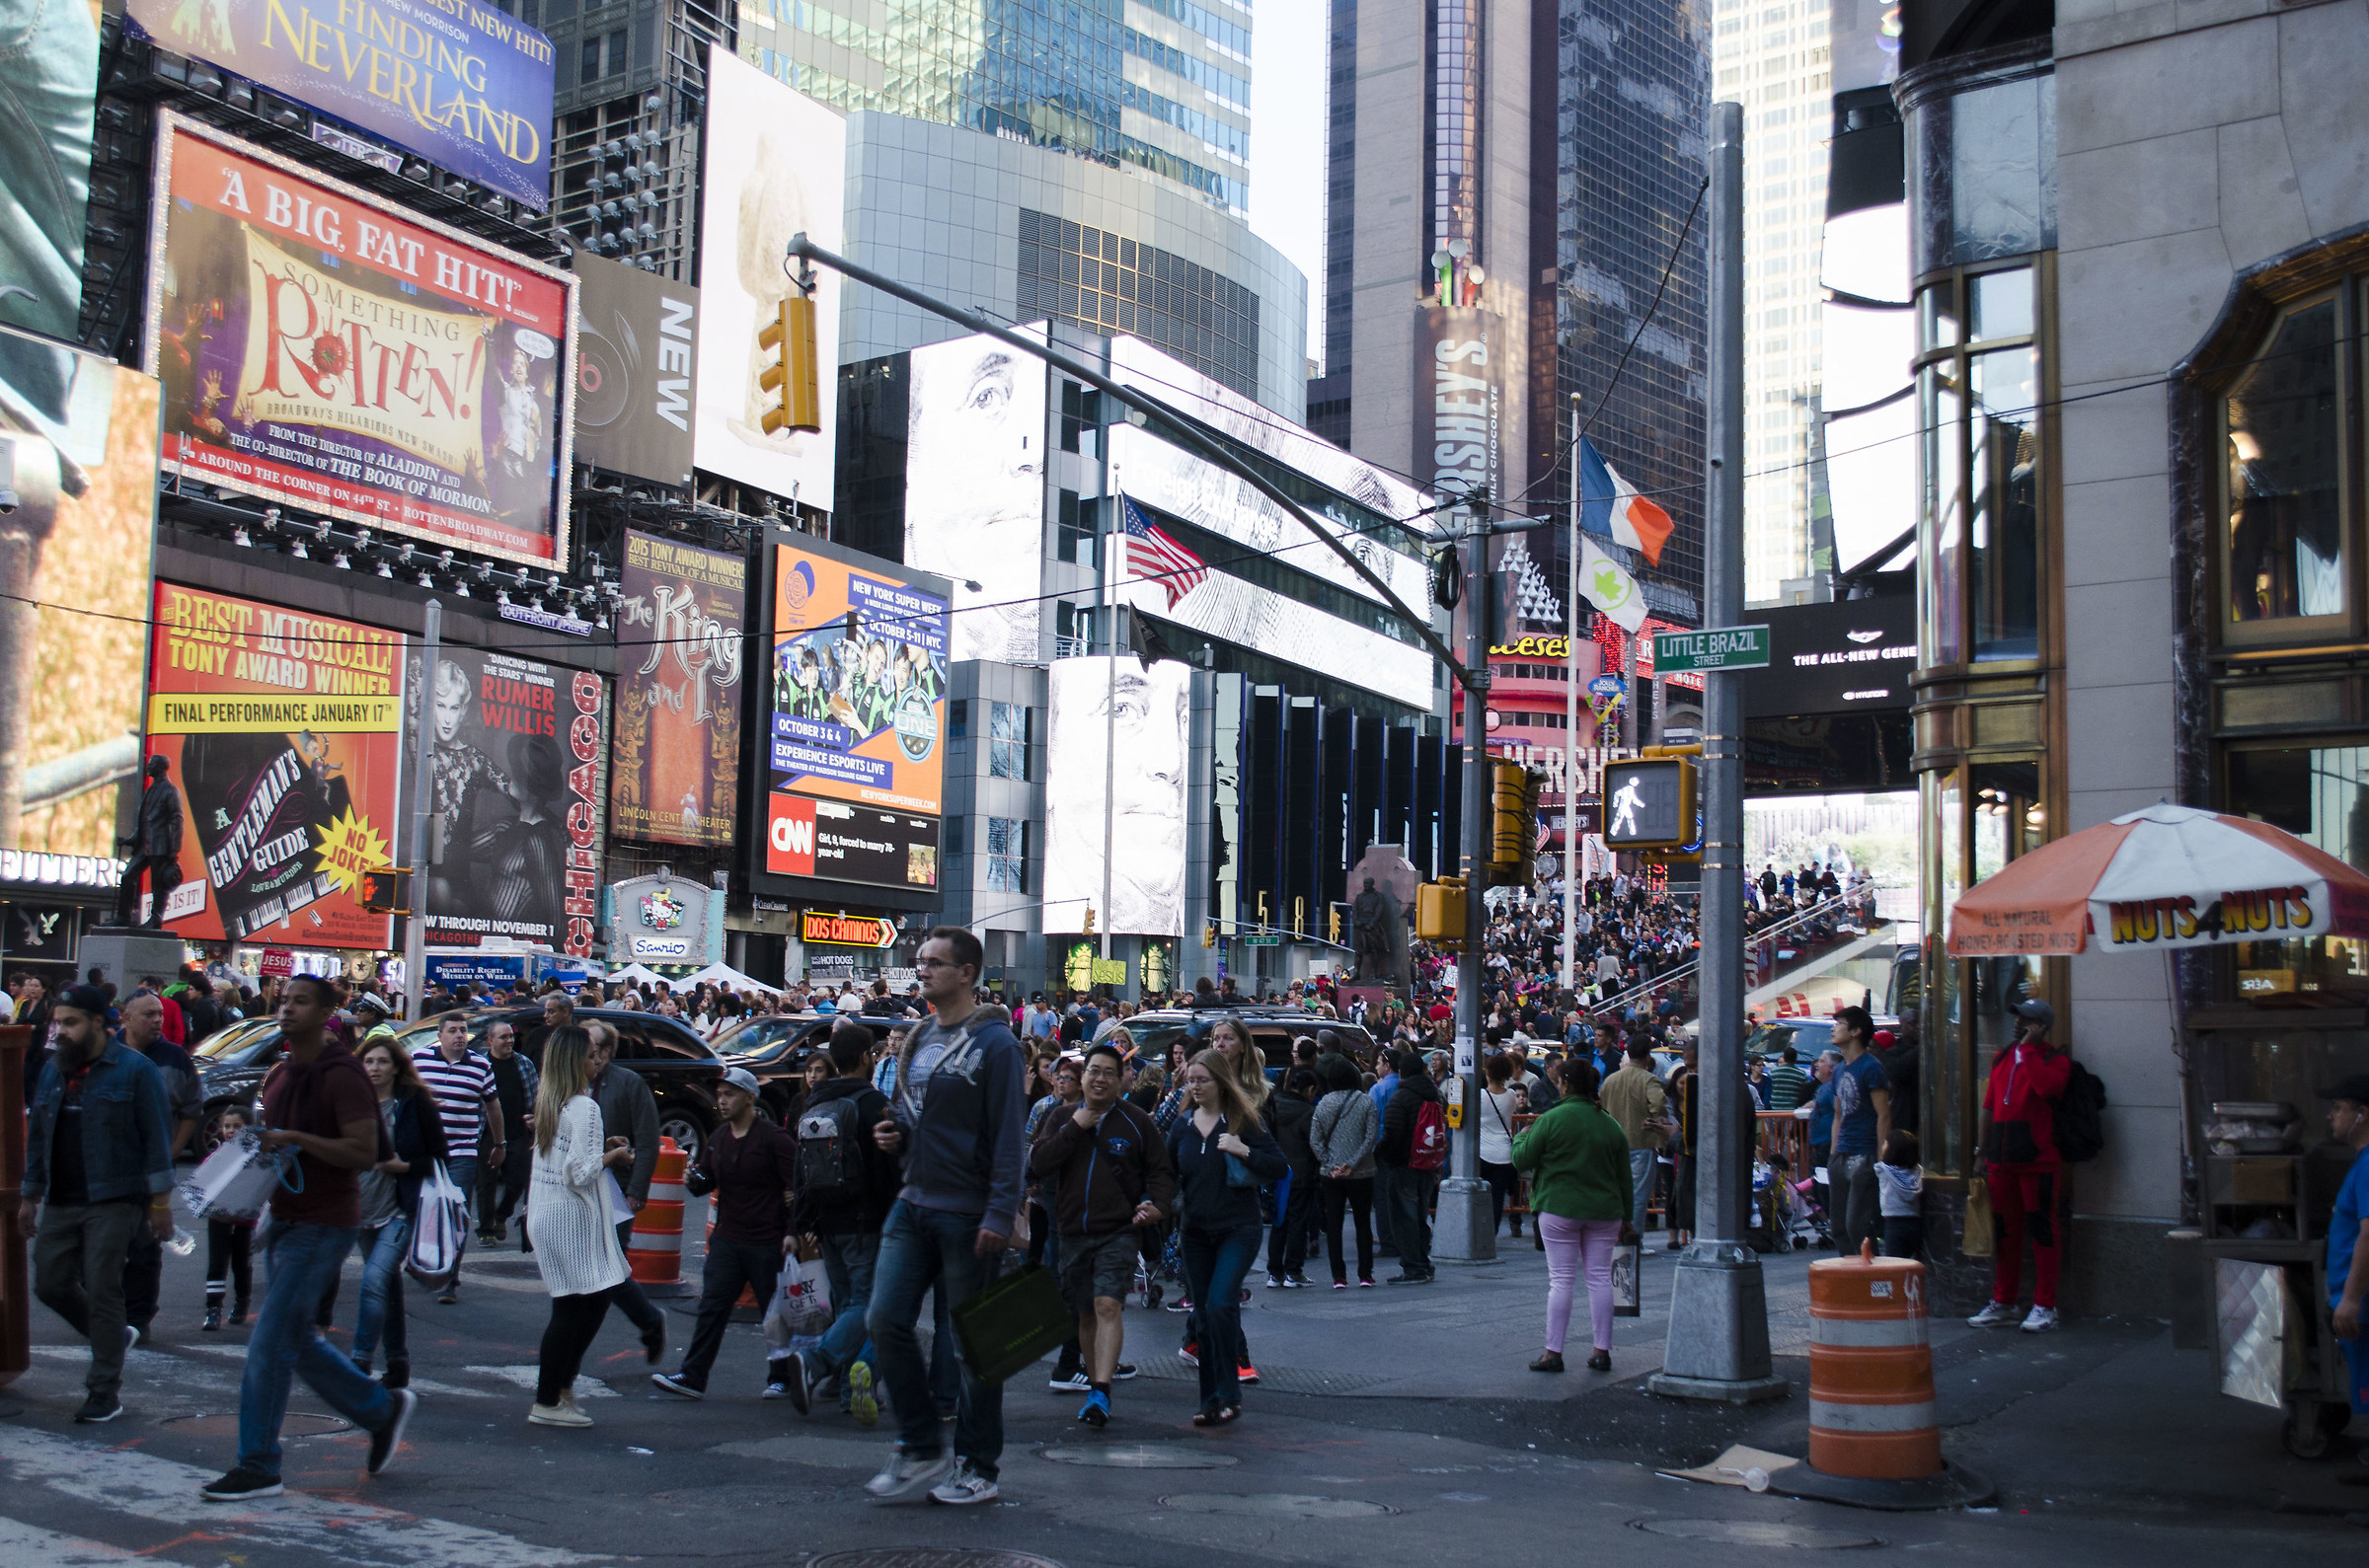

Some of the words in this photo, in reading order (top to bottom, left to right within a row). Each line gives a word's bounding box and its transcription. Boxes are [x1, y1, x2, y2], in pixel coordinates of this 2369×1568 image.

[415, 8, 470, 44] MORRISON
[470, 11, 512, 44] NEW
[514, 31, 552, 66] HIT!
[338, 0, 487, 93] FINDING
[261, 0, 540, 165] NEVERLAND
[265, 184, 346, 253] BIG,
[356, 220, 424, 277] FAT
[283, 261, 462, 341] SOMETHING
[656, 297, 693, 431] NEW
[337, 411, 394, 437] HILARIOUS
[398, 429, 420, 446] NEW
[1490, 385, 1498, 468] CHOCOLATE
[268, 424, 296, 442] FROM
[298, 433, 317, 449] THE
[319, 438, 362, 461] DIRECTOR
[364, 451, 376, 464] OF
[376, 452, 440, 483] ALADDIN
[442, 475, 461, 488] AND
[231, 432, 251, 449] THE
[253, 439, 315, 468] CO-DIRECTOR
[316, 457, 328, 471] OF
[331, 458, 362, 479] THE
[365, 466, 405, 491] BOOK
[409, 480, 427, 496] OF
[429, 485, 492, 514] MORMON
[198, 452, 252, 476] AROUND
[255, 466, 280, 484] THE
[283, 475, 331, 496] CORNER
[334, 487, 350, 501] ON
[404, 505, 528, 548] ROTTENBROADWAY.COM
[628, 553, 650, 565] BEST
[651, 560, 687, 576] REVIVAL
[688, 567, 699, 578] OF
[700, 570, 708, 581] A
[709, 573, 744, 590] MUSICAL
[629, 536, 649, 557] 2015
[650, 542, 674, 562] TONY
[675, 548, 708, 570] AWARD
[709, 556, 744, 579] WINNER!
[623, 596, 654, 629] The
[853, 579, 873, 596] NEW
[873, 586, 894, 604] YORK
[895, 593, 920, 611] SUPER
[921, 600, 944, 617] WEEK
[503, 605, 558, 627] OUTFRONT
[170, 591, 253, 648] BEST
[259, 609, 393, 675] MUSICAL!
[639, 585, 744, 688] King
[869, 621, 905, 640] OCTOBER
[906, 629, 921, 644] 5-11
[926, 635, 942, 649] NYC
[1662, 635, 1706, 657] LITTLE
[1709, 632, 1759, 654] BRAZIL
[170, 638, 229, 676] TONY
[235, 651, 308, 690] AWARD
[314, 665, 391, 696] WINNER
[483, 664, 497, 676] THE
[524, 674, 555, 688] WINNER
[527, 660, 547, 674] WITH
[1694, 654, 1725, 666] STREET
[1793, 654, 1819, 667] THE
[482, 675, 556, 712] RUMER
[648, 679, 689, 715] and
[688, 656, 715, 727] I
[166, 703, 205, 722] FINAL
[209, 703, 308, 722] PERFORMANCE
[312, 704, 369, 722] JANUARY
[481, 703, 556, 738] WILLIS
[895, 712, 937, 739] ONE
[779, 718, 819, 738] OCTOBER
[819, 727, 826, 739] 3
[826, 729, 834, 740] &
[834, 730, 841, 742] 4
[776, 743, 827, 765] EXPERIENCE
[828, 754, 866, 773] ESPORTS
[867, 761, 885, 776] LIVE
[786, 760, 807, 772] THEATER
[808, 764, 815, 773] AT
[815, 765, 836, 777] MADISON
[837, 769, 855, 781] SQUARE
[856, 773, 875, 784] GARDEN
[564, 671, 603, 958] CHICAGO
[619, 805, 655, 821] LINCOLN
[861, 789, 936, 810] NEWYORKSUPERWEEK.COM
[207, 748, 302, 889] GENTLEMAN'S
[215, 807, 233, 830] A
[253, 826, 310, 872] GUIDE
[345, 827, 368, 851] NO
[771, 817, 813, 856] CNN
[817, 832, 831, 846] Girl,
[839, 835, 859, 849] forced
[859, 839, 867, 850] to
[867, 841, 884, 854] marry
[817, 847, 844, 859] year-old
[174, 892, 185, 909] IS
[251, 881, 269, 893] LOVE
[439, 916, 491, 932] THROUGH
[493, 920, 547, 936] NOVEMBER
[549, 925, 554, 936] 1
[806, 916, 829, 939] DOS
[830, 918, 879, 943] CAMINOS
[1983, 912, 2000, 927] ALL
[2004, 910, 2052, 926] NATURAL
[2109, 895, 2198, 944] NUTS
[2195, 901, 2225, 940] 4
[2222, 885, 2313, 933] NUTS
[2048, 932, 2077, 948] NUTS
[263, 954, 293, 967] JESUS
[820, 955, 834, 965] HOT
[834, 955, 854, 965] DOGS
[888, 967, 900, 979] HOT
[900, 967, 917, 980] DOGS
[801, 1279, 815, 1295] NY
